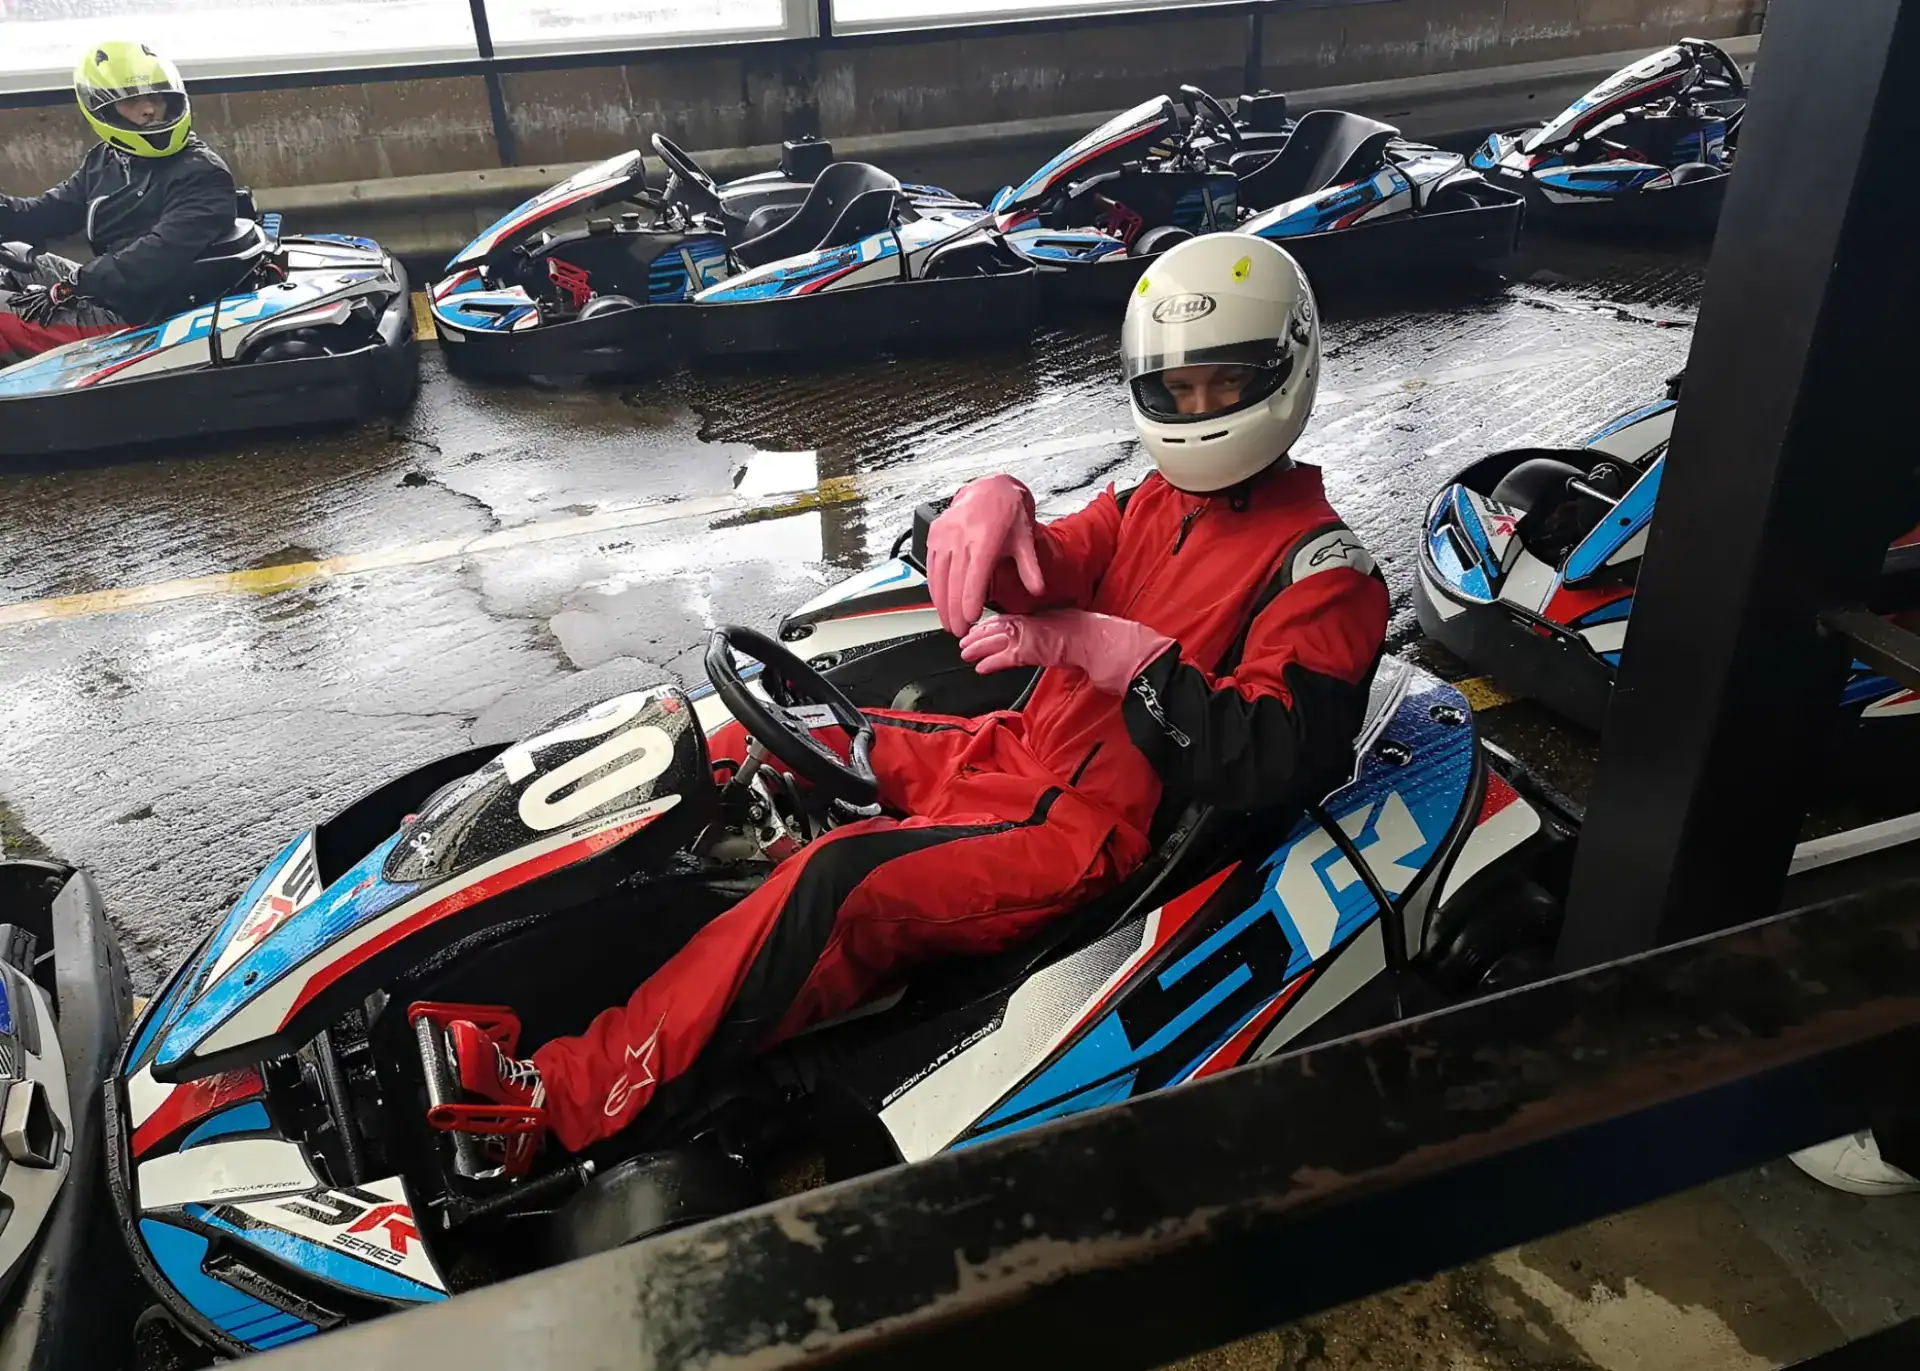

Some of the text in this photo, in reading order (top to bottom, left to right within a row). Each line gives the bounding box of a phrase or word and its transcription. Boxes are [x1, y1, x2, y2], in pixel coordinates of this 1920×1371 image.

[1155, 296, 1207, 319] Arai
[881, 1021, 997, 1107] SODIKART.COM
[332, 1232, 406, 1267] SERIES
